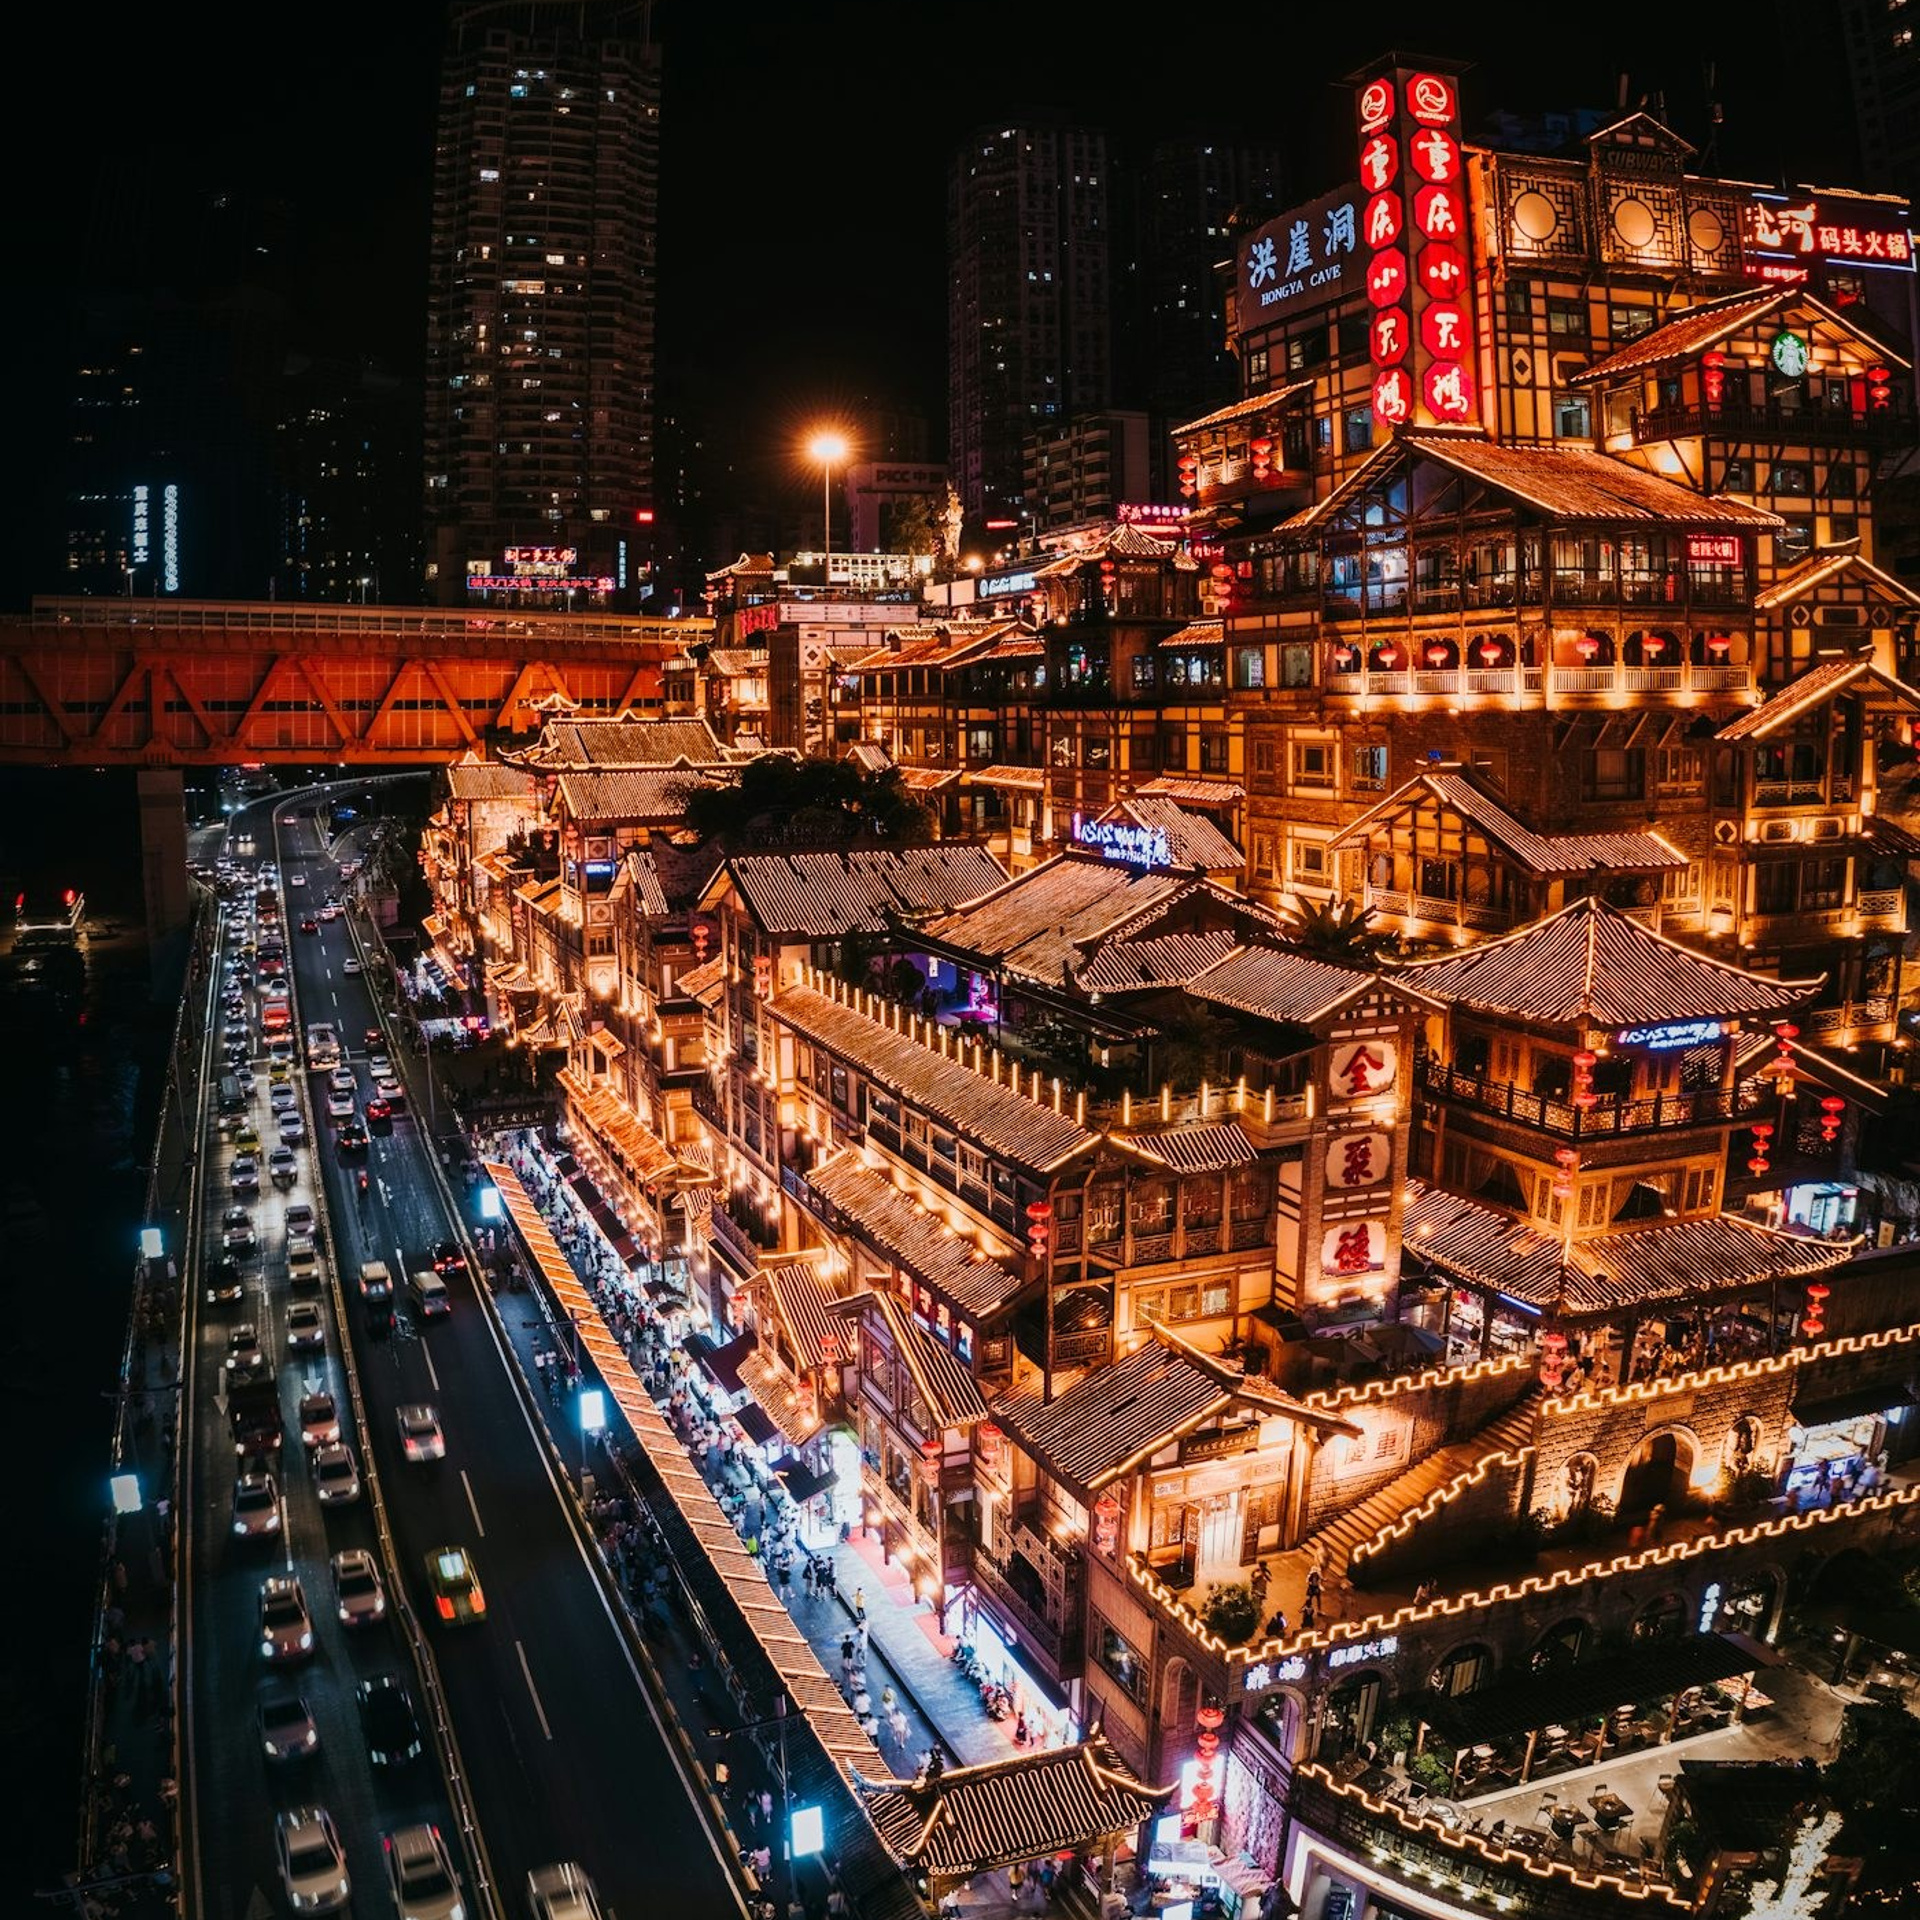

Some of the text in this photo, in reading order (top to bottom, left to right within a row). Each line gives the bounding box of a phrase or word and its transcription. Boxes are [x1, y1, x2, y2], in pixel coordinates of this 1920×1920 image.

[1606, 150, 1672, 171] SUBWAY
[1247, 202, 1356, 288] 洪崖洞
[1261, 264, 1342, 306] HONGYA CAVE
